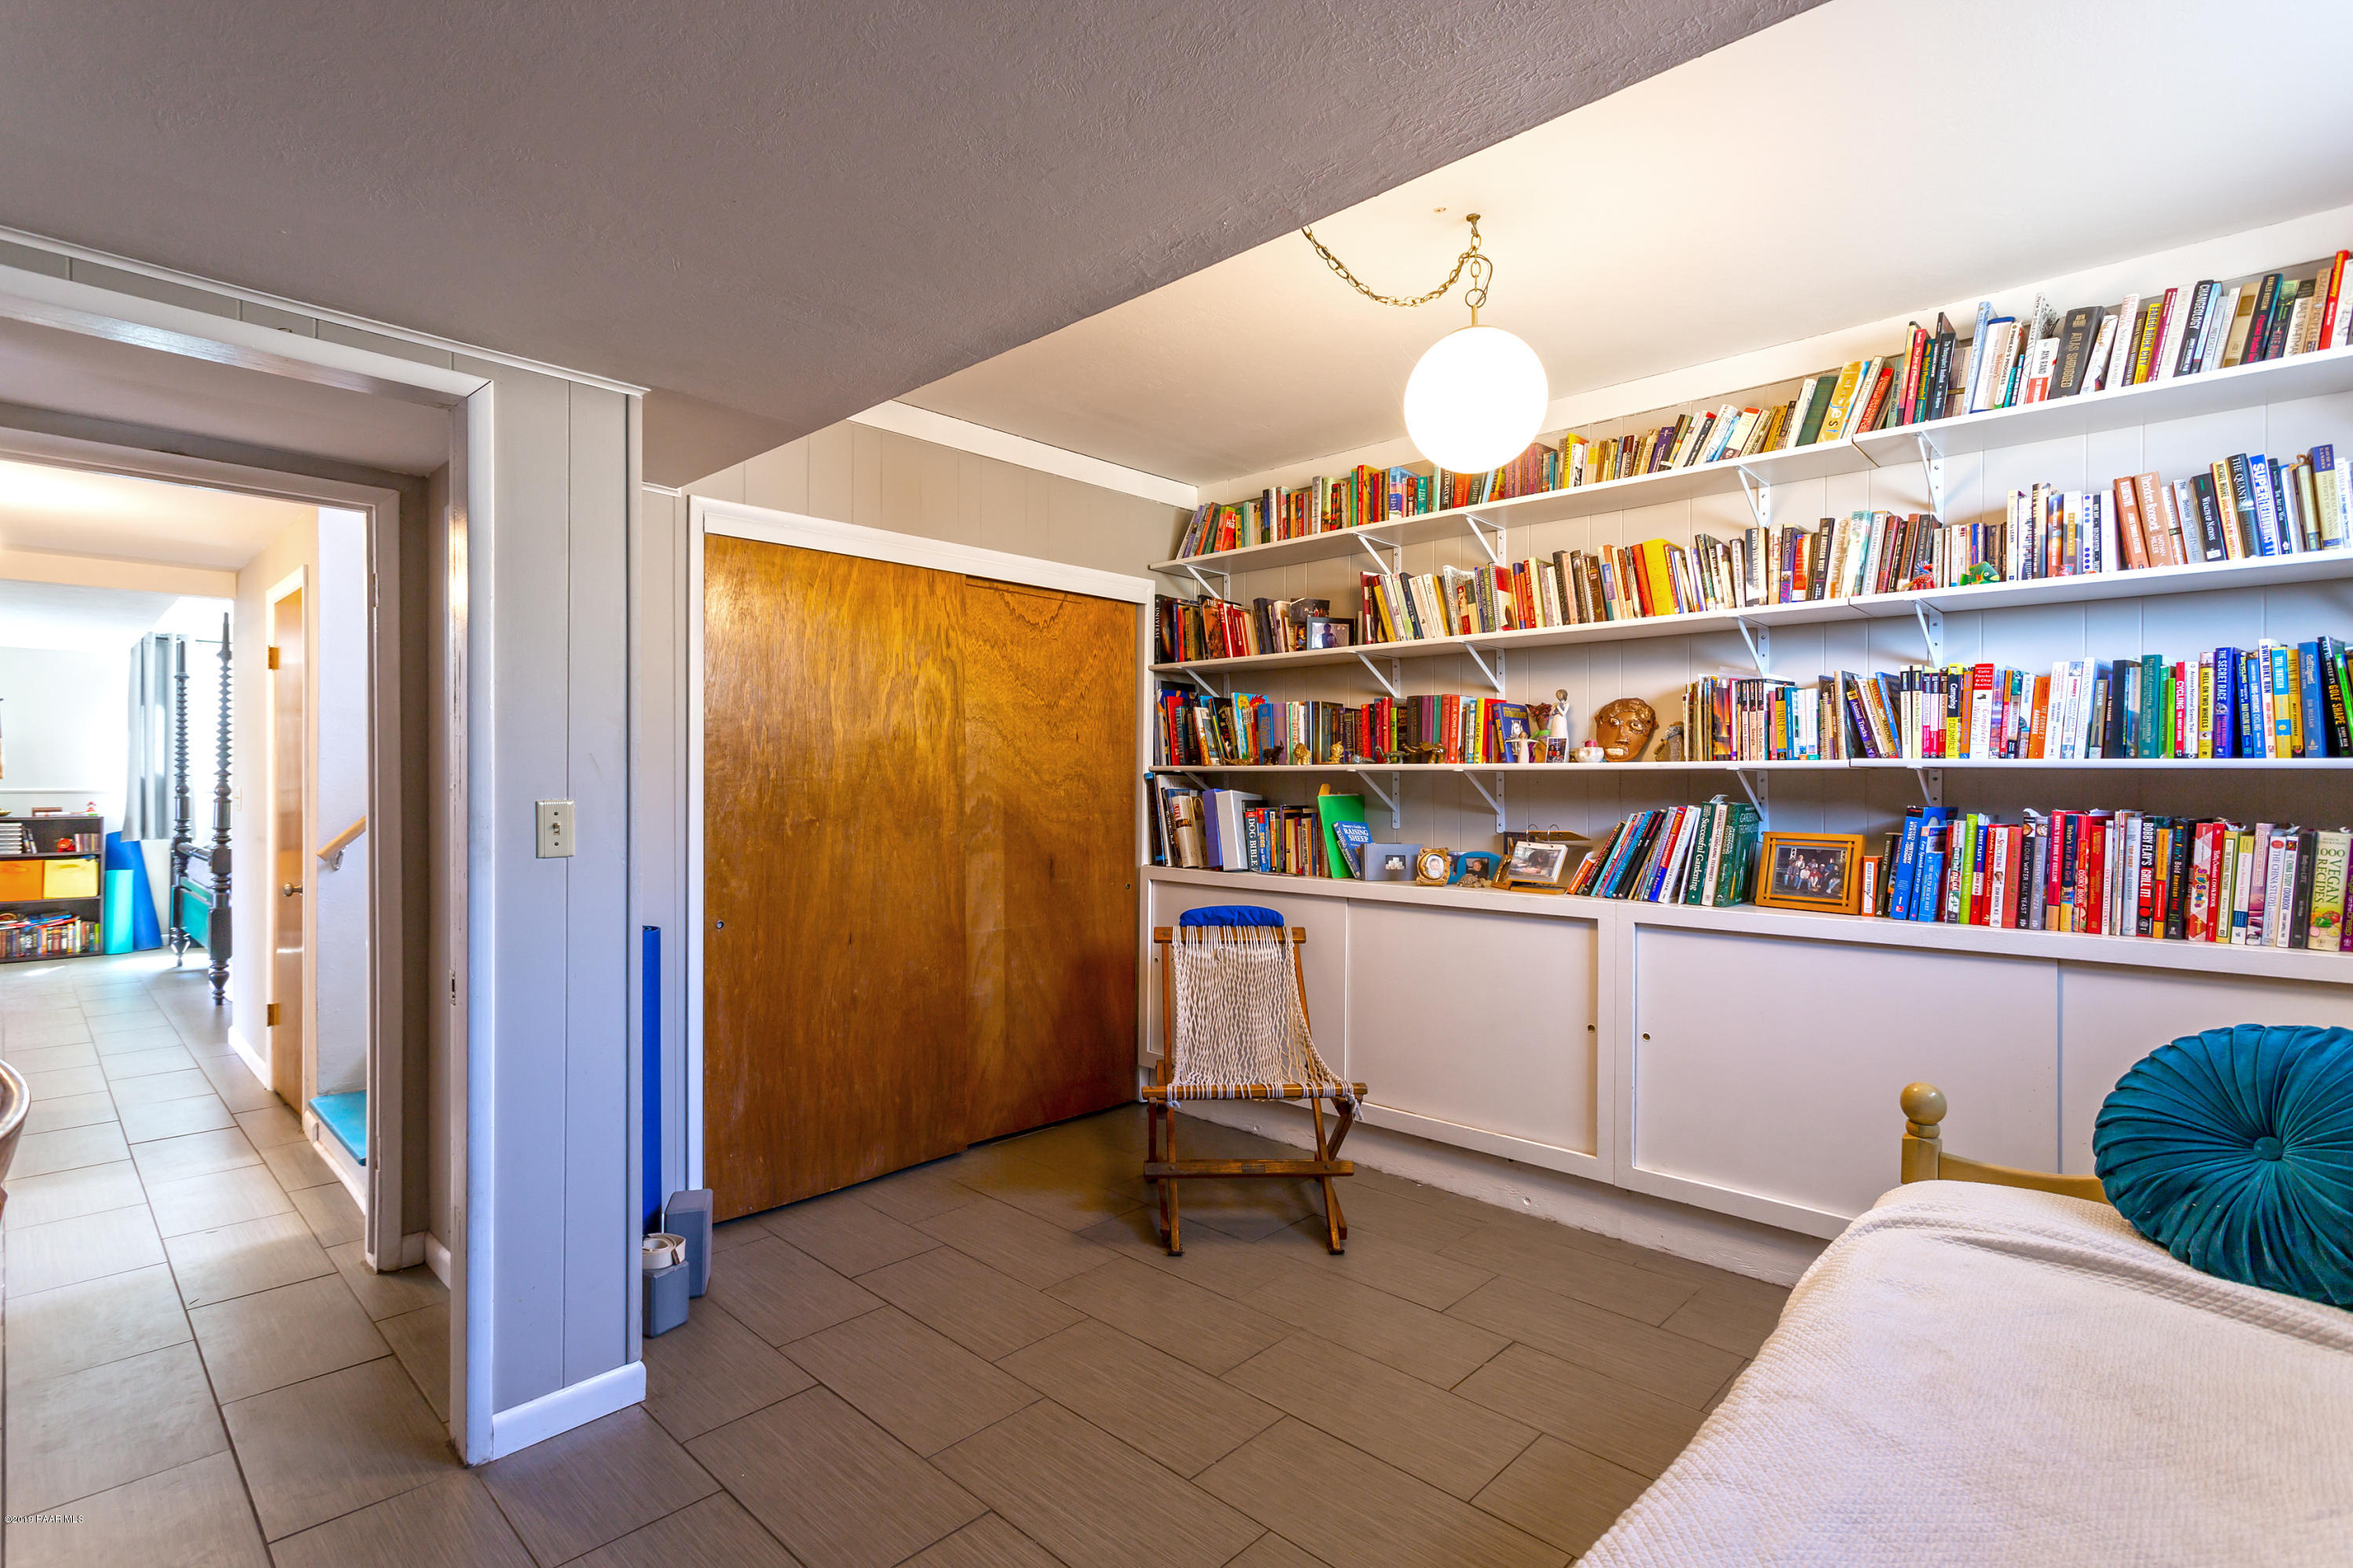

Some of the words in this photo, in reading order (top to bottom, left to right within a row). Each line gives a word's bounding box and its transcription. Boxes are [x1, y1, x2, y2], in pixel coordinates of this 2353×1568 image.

[2146, 306, 2160, 328] FARGO
[2189, 284, 2210, 329] CHANGEOLOGY
[2296, 299, 2309, 318] WALT
[2006, 330, 2016, 358] PINHEAD'S
[2068, 333, 2082, 351] ATLAS
[2142, 329, 2155, 347] ROCK
[2040, 351, 2049, 360] AYN
[2139, 350, 2150, 366] CITY
[1867, 363, 1878, 379] Frank
[2000, 358, 2011, 385] PROGRESS
[2038, 361, 2048, 374] RAND
[2060, 353, 2078, 387] SHRUGGED
[1908, 370, 1918, 400] Photography
[2217, 464, 2227, 482] MICHAEL
[2232, 457, 2243, 472] THE
[2140, 475, 2155, 503] Theodore
[2220, 482, 2230, 497] MOORE
[2234, 474, 2247, 504] QUANTS
[2202, 497, 2213, 515] WEALTH
[2253, 463, 2276, 543] SUPERFREAKONOMICS
[2206, 521, 2216, 540] NATIONS
[1820, 537, 1828, 558] AMERICAN
[2158, 534, 2166, 556] NATHAN
[2217, 660, 2227, 684] SECRET
[1948, 683, 1958, 709] Camping
[2176, 681, 2184, 709] CYCLING
[2217, 685, 2226, 700] RACE
[2328, 685, 2340, 701] GOLF
[1777, 710, 1785, 736] BIRDS
[1852, 701, 1862, 719] Animal
[1858, 721, 1867, 737] Tracks
[2332, 703, 2346, 725] SHAPE
[1882, 719, 1893, 744] ARIZONA
[1947, 722, 1956, 750] DUMMIES
[1980, 708, 1989, 743] Complete
[1671, 813, 1682, 834] Home
[2143, 822, 2154, 843] BOBBY
[1697, 817, 1710, 853] Successful
[1249, 840, 1258, 866] BIBLE
[1660, 834, 1675, 868] Improvement
[1952, 847, 1961, 871] EVERYDAY
[2141, 845, 2152, 866] FLAY'S
[2272, 850, 2281, 863] THE
[1689, 854, 1704, 891] Gardening
[2140, 869, 2151, 887] GRILL
[2173, 861, 2182, 873] Bold
[2270, 864, 2280, 884] CHINA
[2172, 875, 2180, 897] American
[2285, 873, 2293, 887] STUDY
[2315, 859, 2328, 903] RECIPES
[2326, 859, 2342, 904] VEGAN
[2140, 889, 2151, 897] IT!
[2268, 885, 2277, 904] STUDY
[2282, 887, 2291, 911] COOKBOOK
